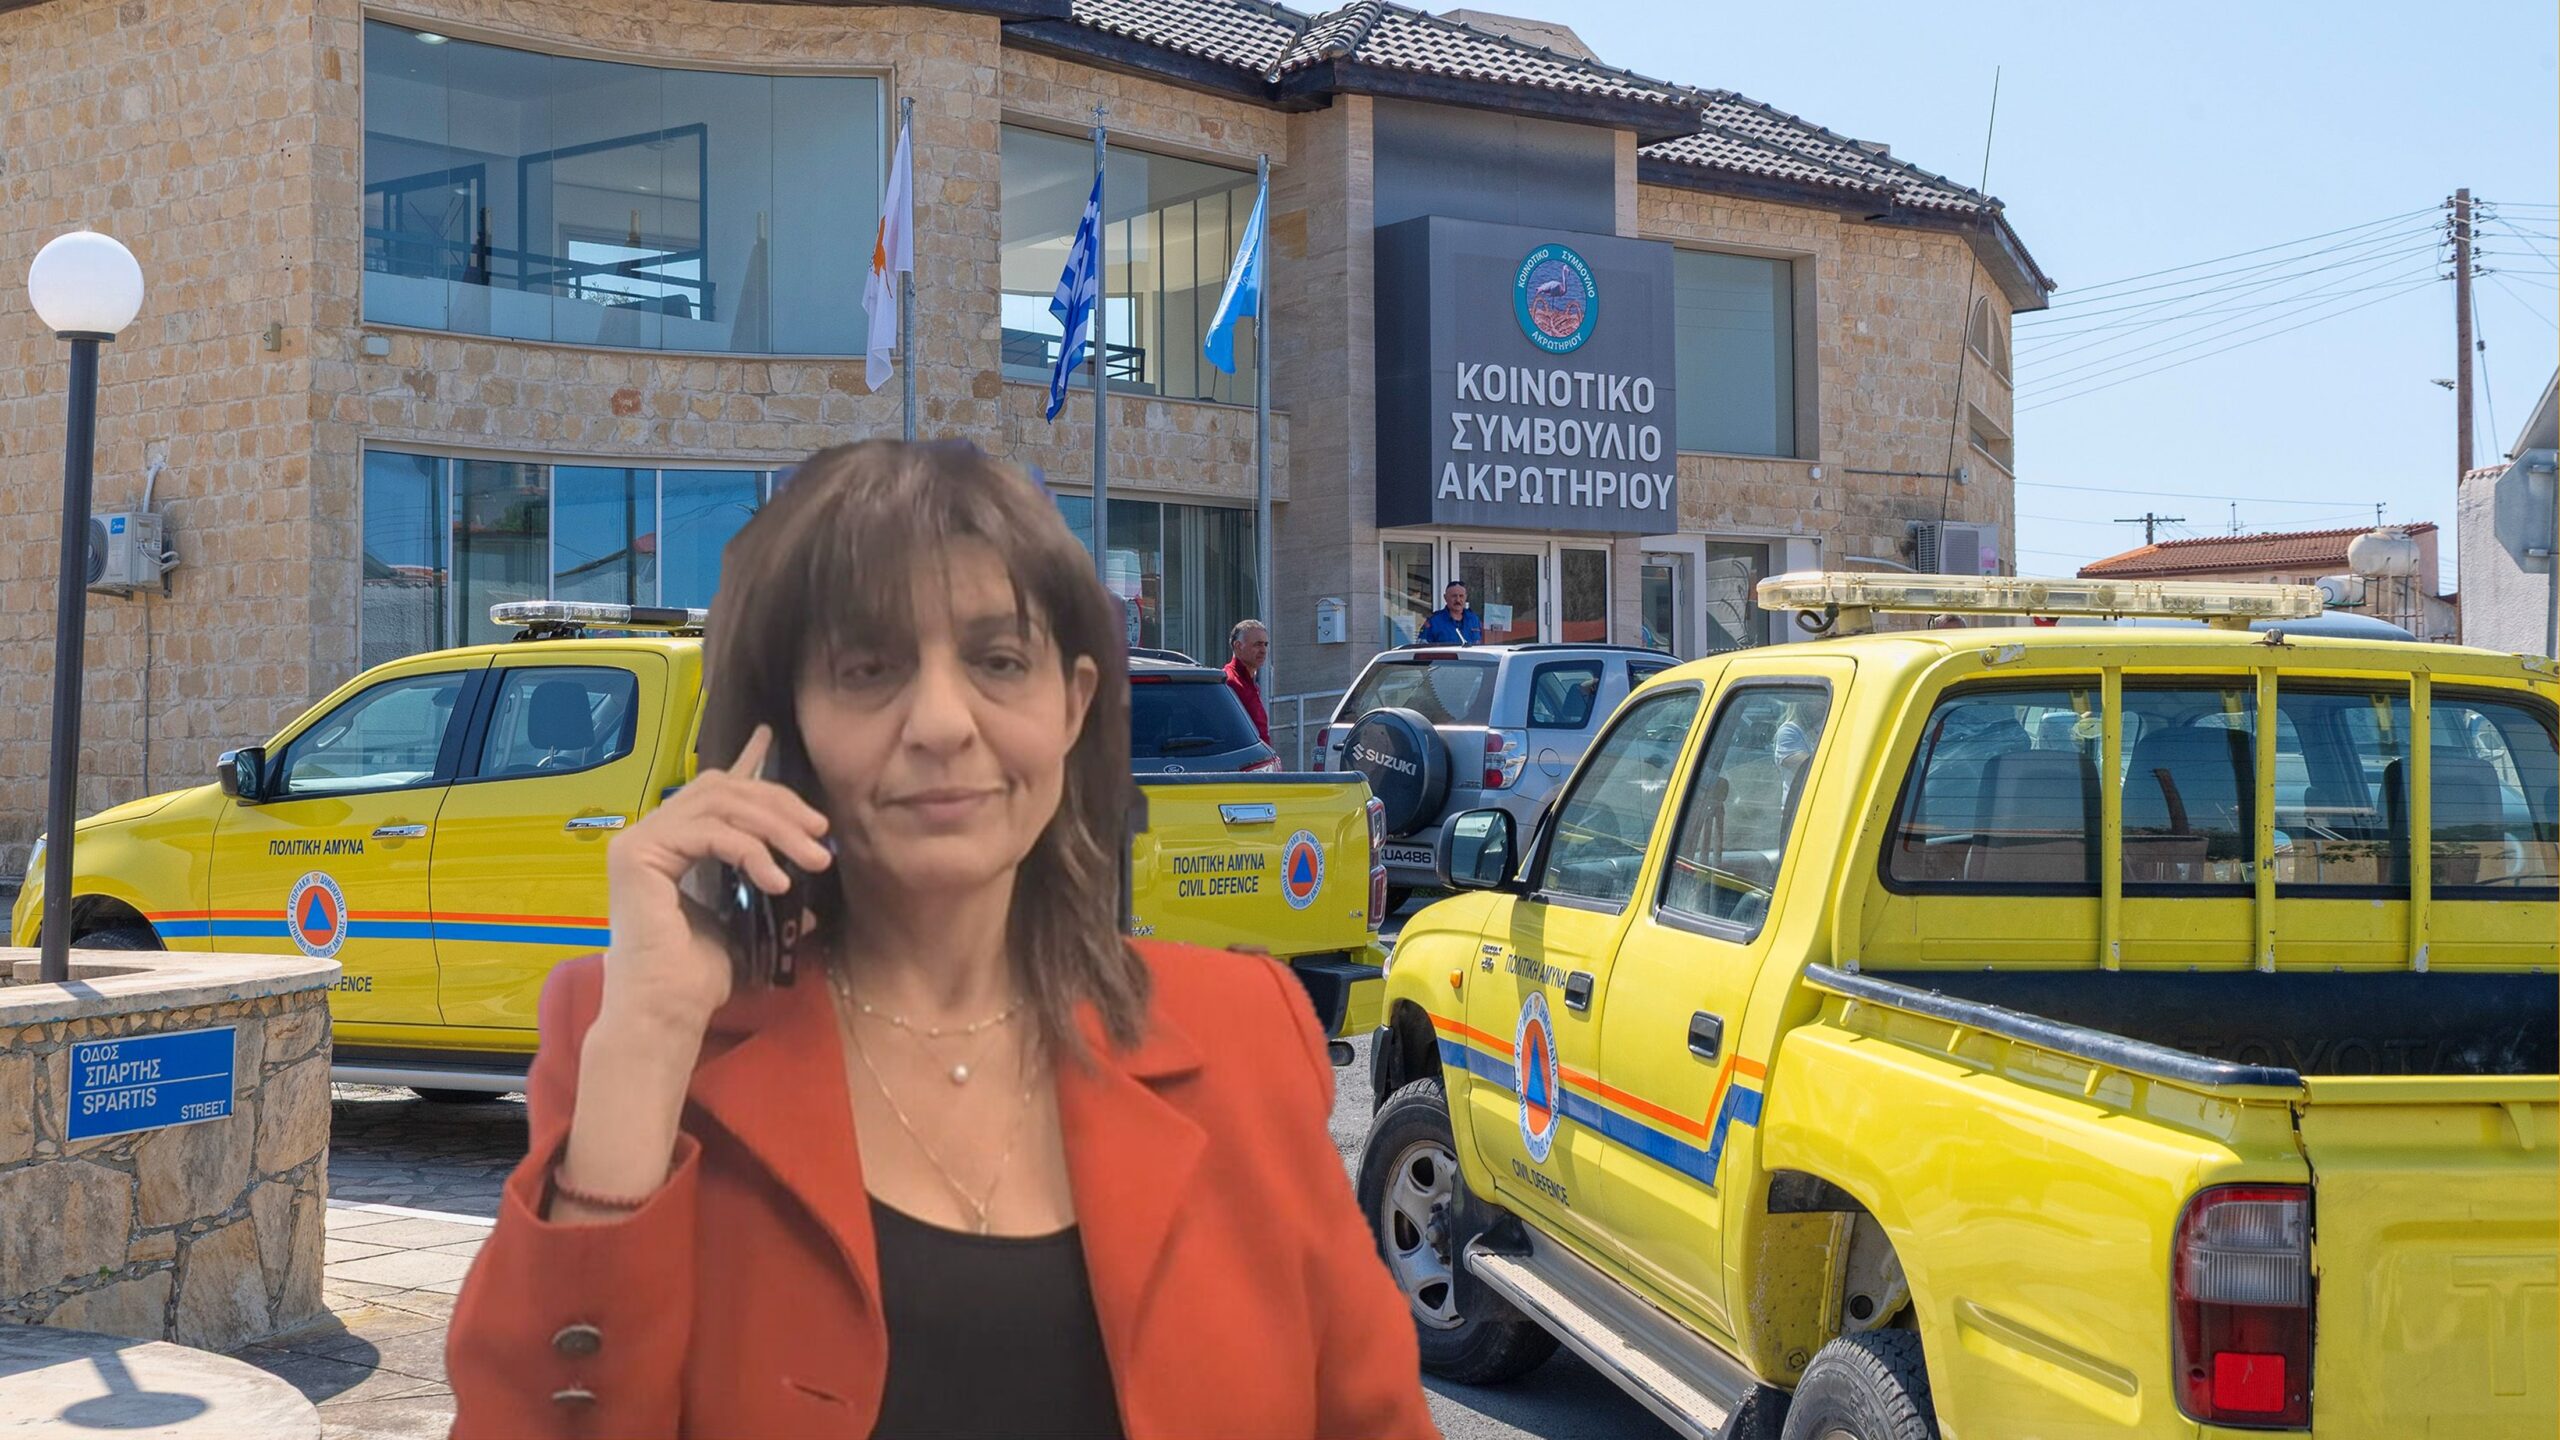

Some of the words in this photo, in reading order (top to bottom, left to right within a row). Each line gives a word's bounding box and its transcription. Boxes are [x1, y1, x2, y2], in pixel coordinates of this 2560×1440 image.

[1518, 249, 1549, 288] ΚΟΙΝΟΤΙΚΟ
[1561, 250, 1595, 298] ΣΥΜΒΟΥΛΙΟ
[1531, 331, 1582, 350] ΑΚΡΩΤΗΡΙΟΥ
[1457, 362, 1655, 414] ΚΟΙΝΟΤΙΚΟ
[1451, 412, 1661, 462] ΣΥΜΒΟΥΛΙΟ
[1437, 462, 1674, 510] ΑΚΡΩΤΗΡΙΟΥ
[1365, 748, 1417, 776] SUZUKI
[269, 839, 322, 856] ΠΟΛΙΤΙΚΗ
[323, 838, 364, 855] ΑΜΥΝΑ
[1173, 855, 1224, 874] ΠΟΛΙΤΙΚΗ
[1227, 853, 1265, 871] ΑΜΥΝΑ
[1178, 879, 1206, 898] CIVIL
[1209, 876, 1259, 895] DEFENCE
[1538, 964, 1567, 990] ΑΜΥΝΑ
[80, 1044, 120, 1063] ΟΔΟΣ
[85, 1058, 161, 1087] ΣΠΑΡΤΗΣ
[82, 1087, 157, 1115] SPARTIS
[181, 1100, 226, 1120] STREET
[1531, 1168, 1570, 1207] DEFENCE
